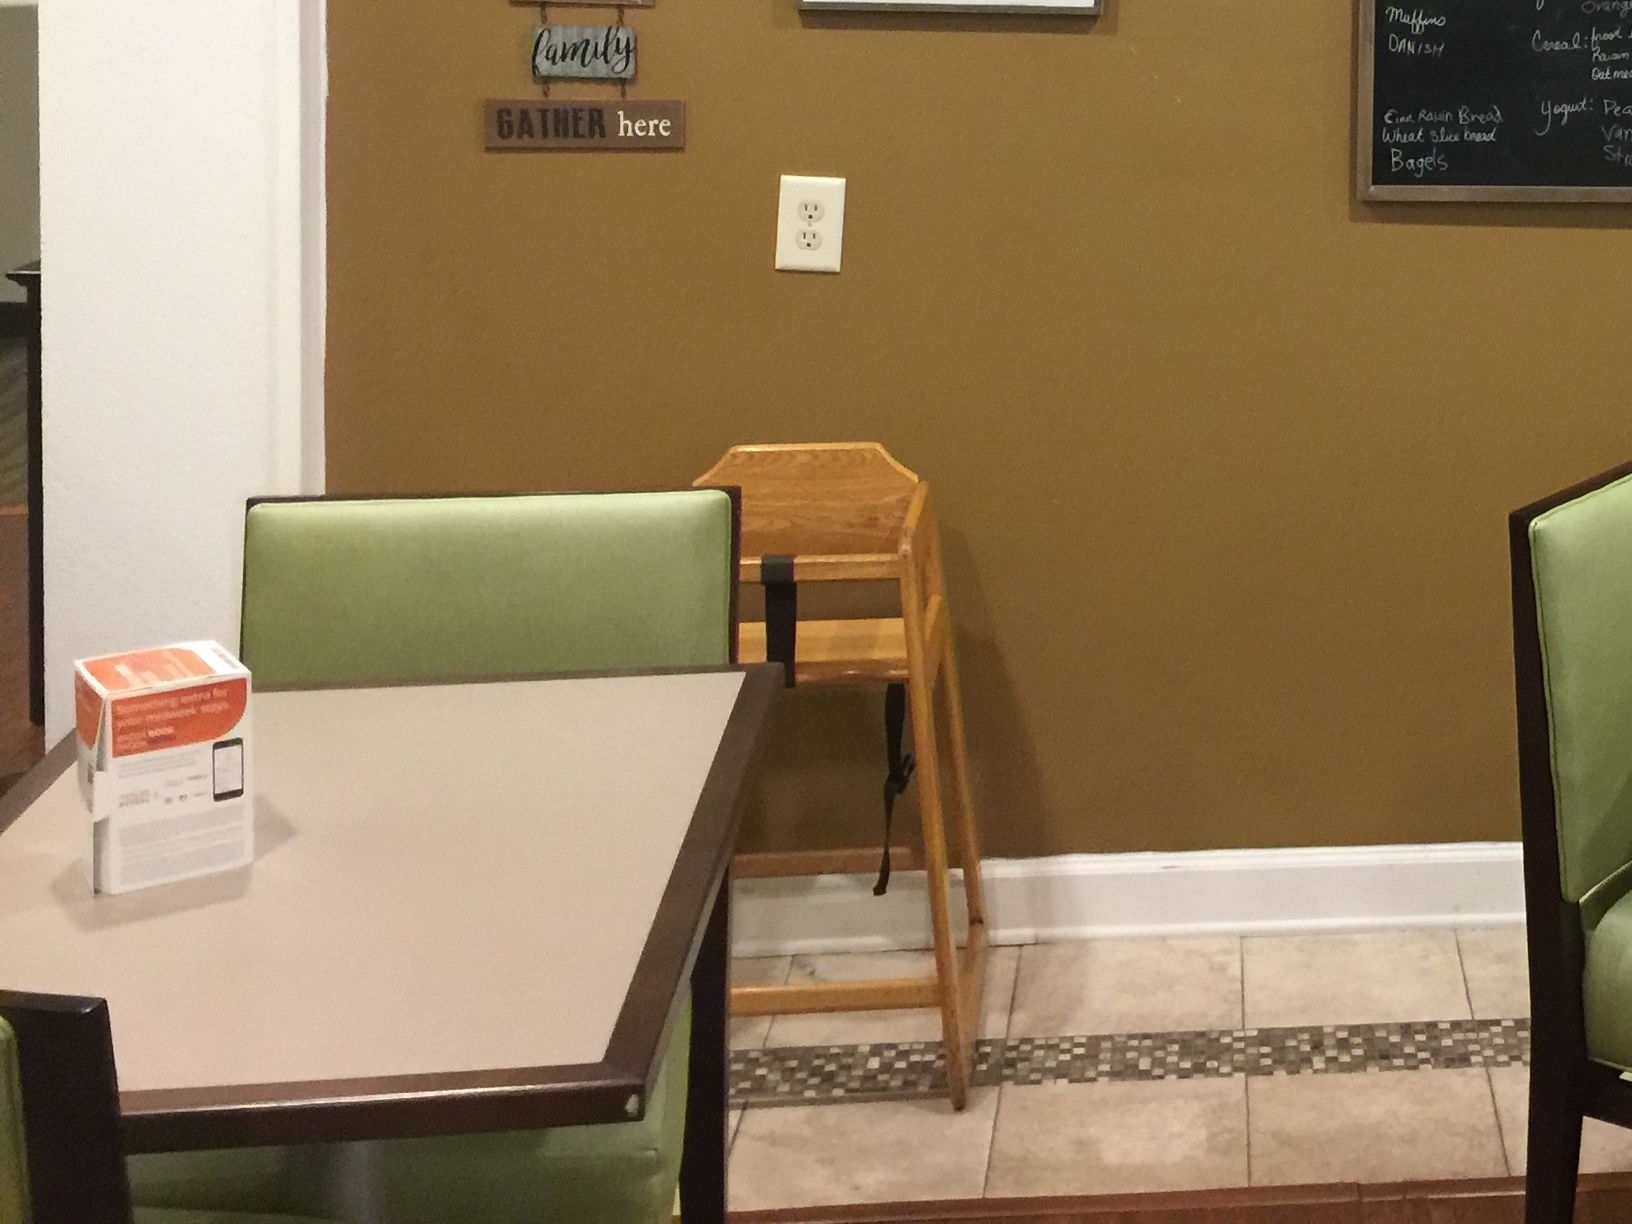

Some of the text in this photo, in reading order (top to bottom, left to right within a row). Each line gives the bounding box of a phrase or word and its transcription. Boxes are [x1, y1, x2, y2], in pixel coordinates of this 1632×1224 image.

[1385, 6, 1446, 35] Muffins
[530, 26, 636, 77] family
[1388, 33, 1445, 57] DANISH
[496, 107, 671, 141] GATHER here
[1458, 104, 1504, 125] Bread
[1382, 126, 1425, 143] Wheat
[1390, 146, 1449, 178] Bagels
